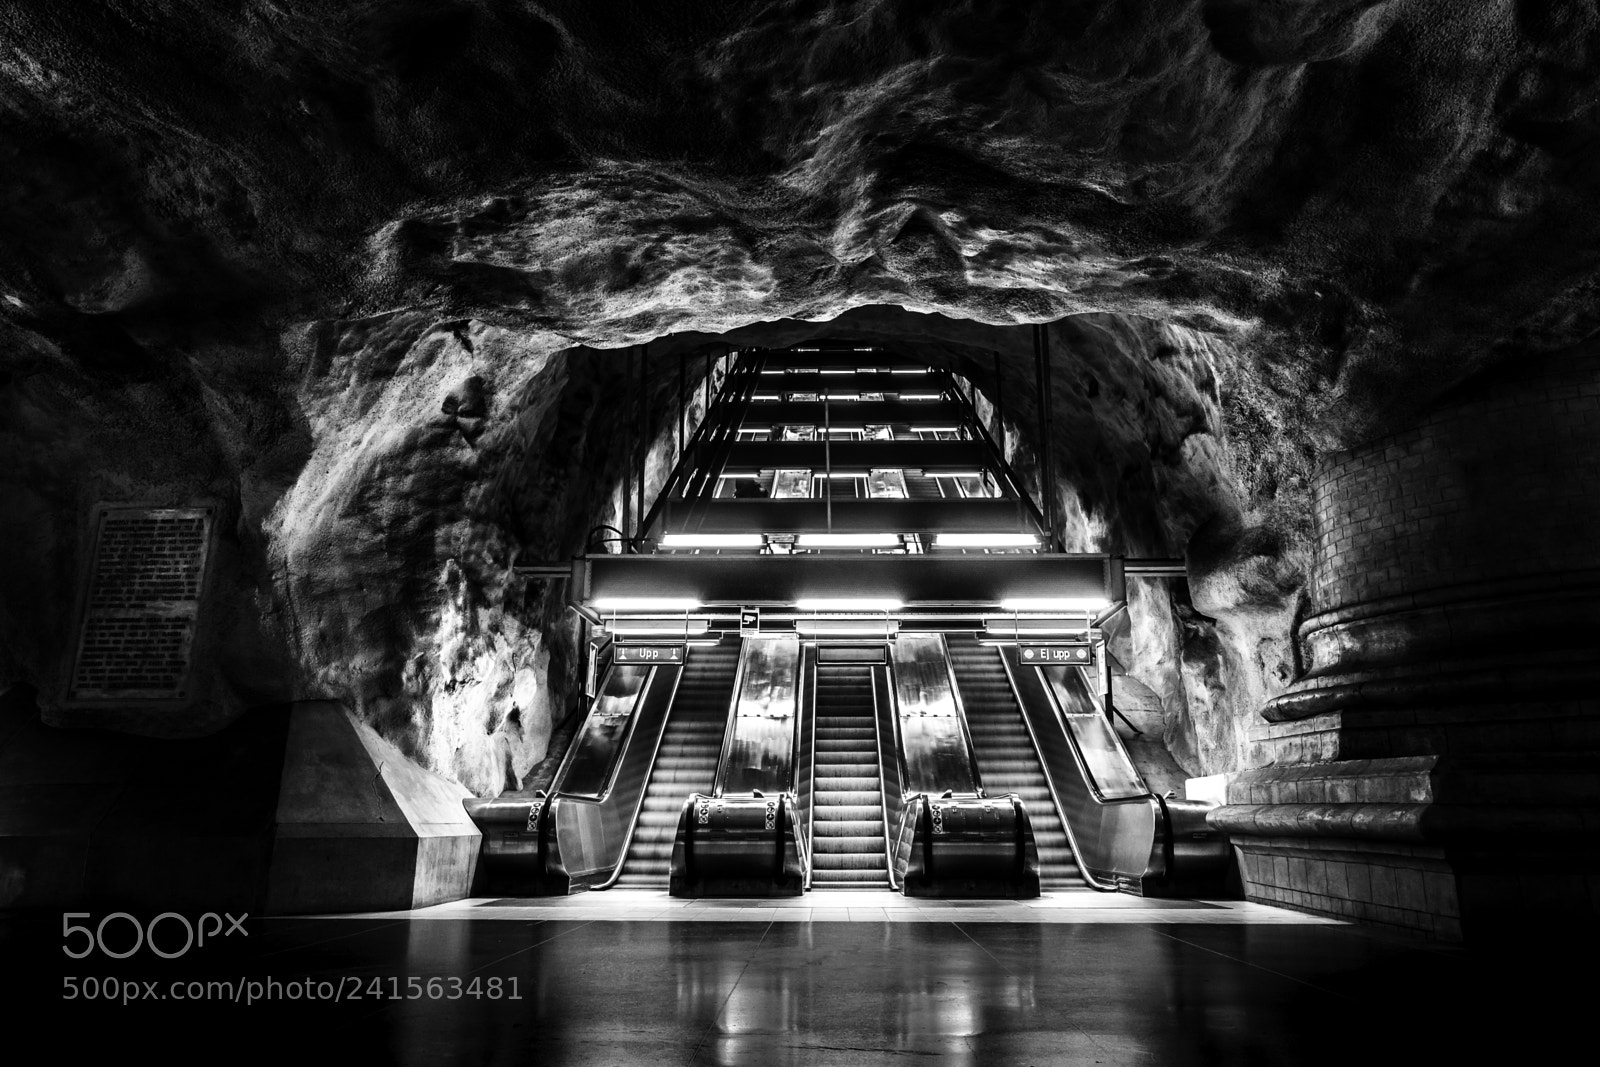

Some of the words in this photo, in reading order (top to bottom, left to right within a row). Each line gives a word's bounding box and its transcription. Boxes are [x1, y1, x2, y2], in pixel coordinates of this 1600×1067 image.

[639, 648, 659, 660] Upp
[1040, 648, 1050, 660] Ej
[1053, 650, 1071, 660] upp
